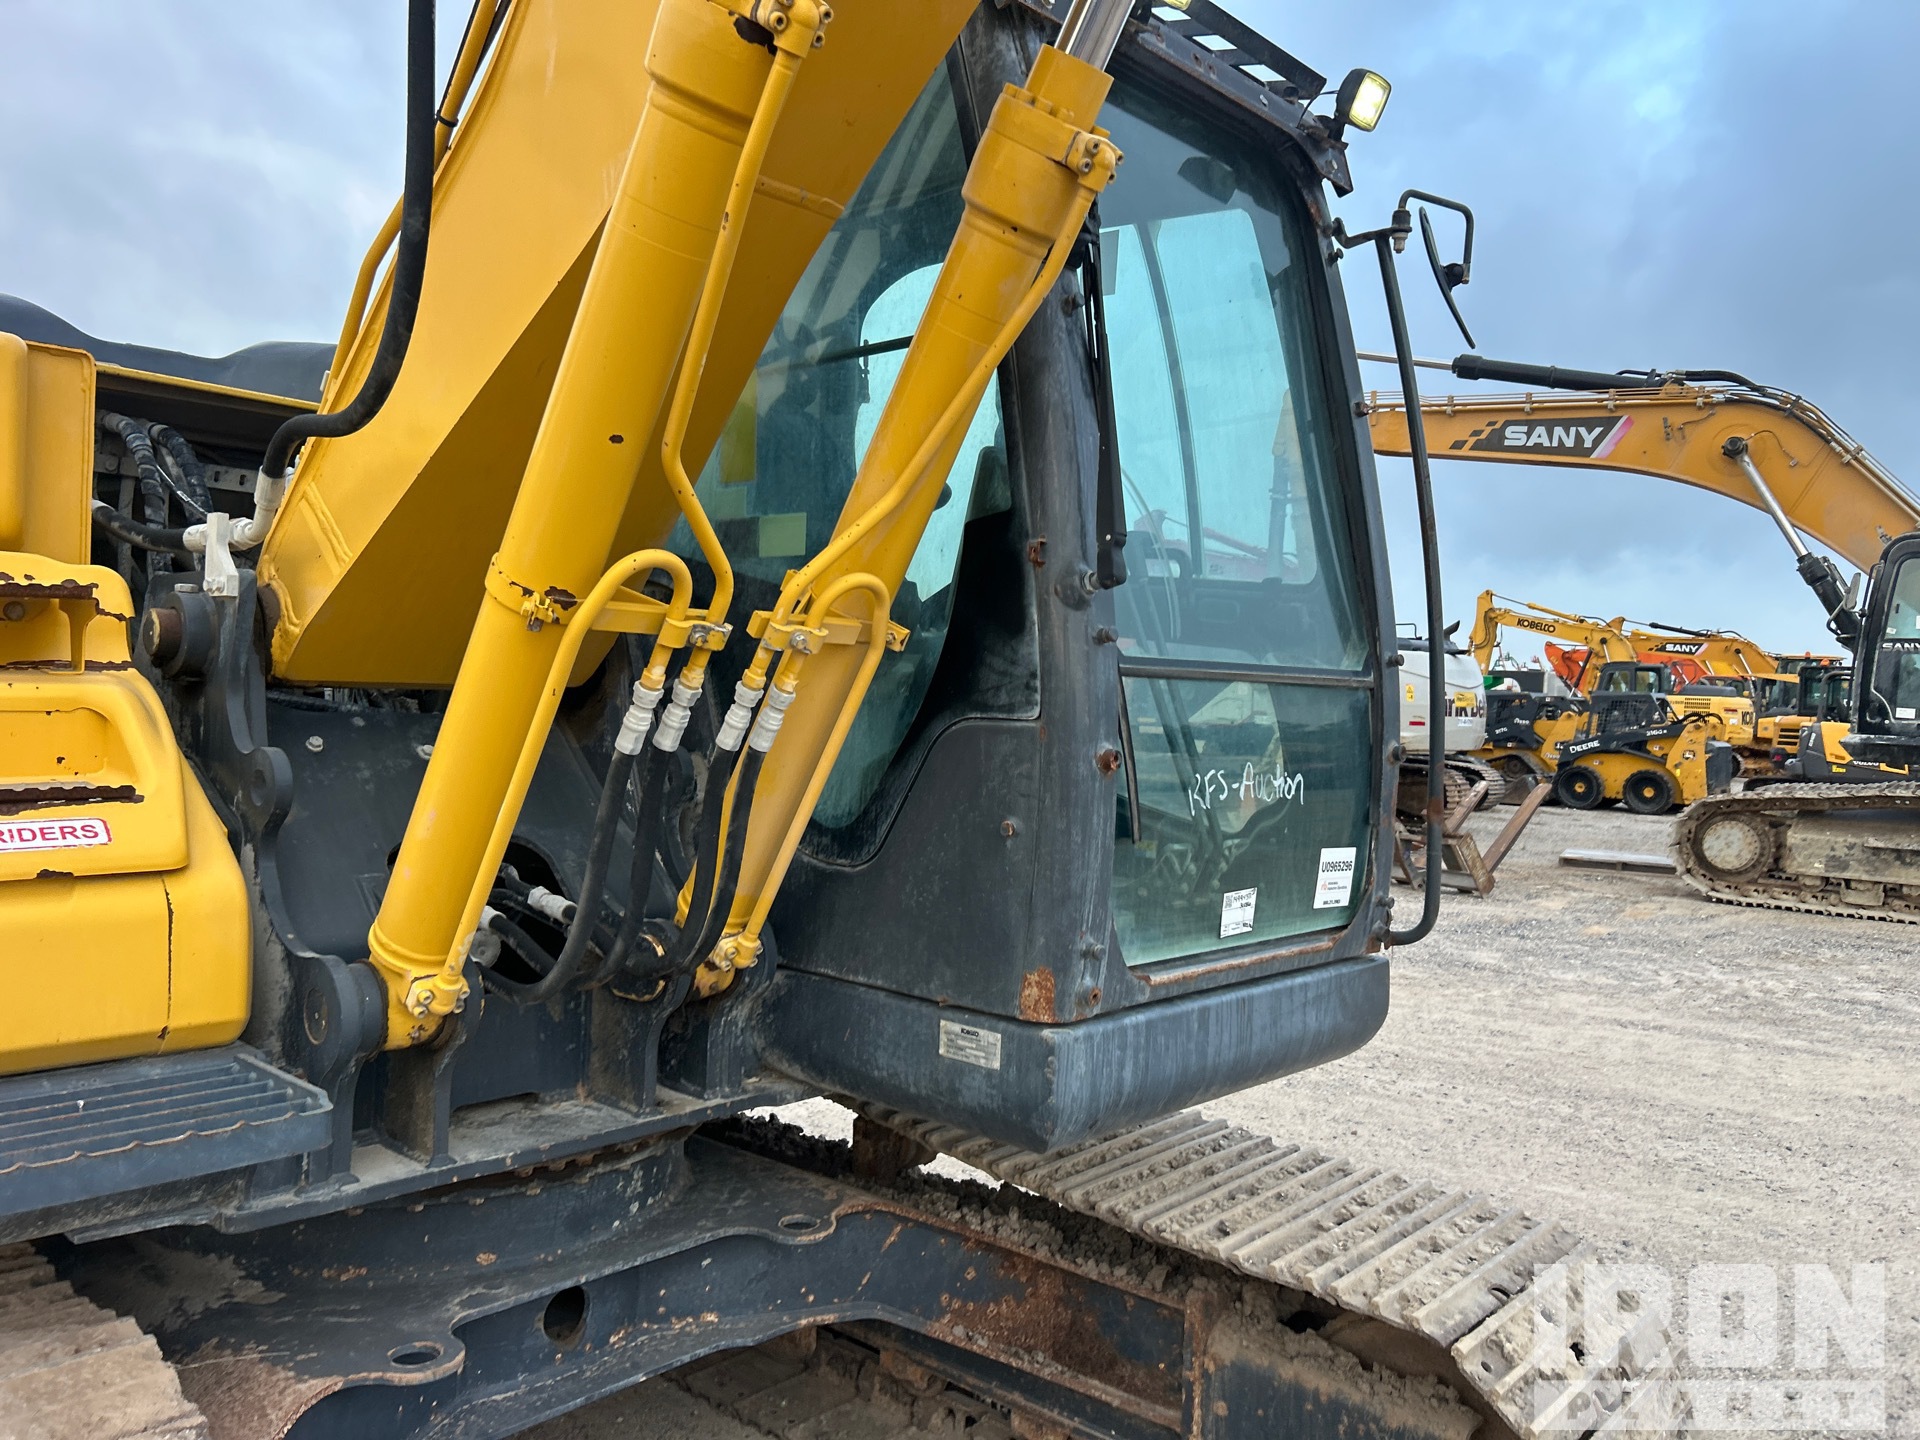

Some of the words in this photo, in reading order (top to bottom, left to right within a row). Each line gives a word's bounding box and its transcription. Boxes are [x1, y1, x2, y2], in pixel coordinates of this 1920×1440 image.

[1503, 425, 1604, 448] SANY
[1516, 617, 1556, 634] KOBELCO
[1665, 643, 1699, 654] SANY
[1569, 739, 1600, 754] DEERE
[1321, 860, 1353, 873] U0965296
